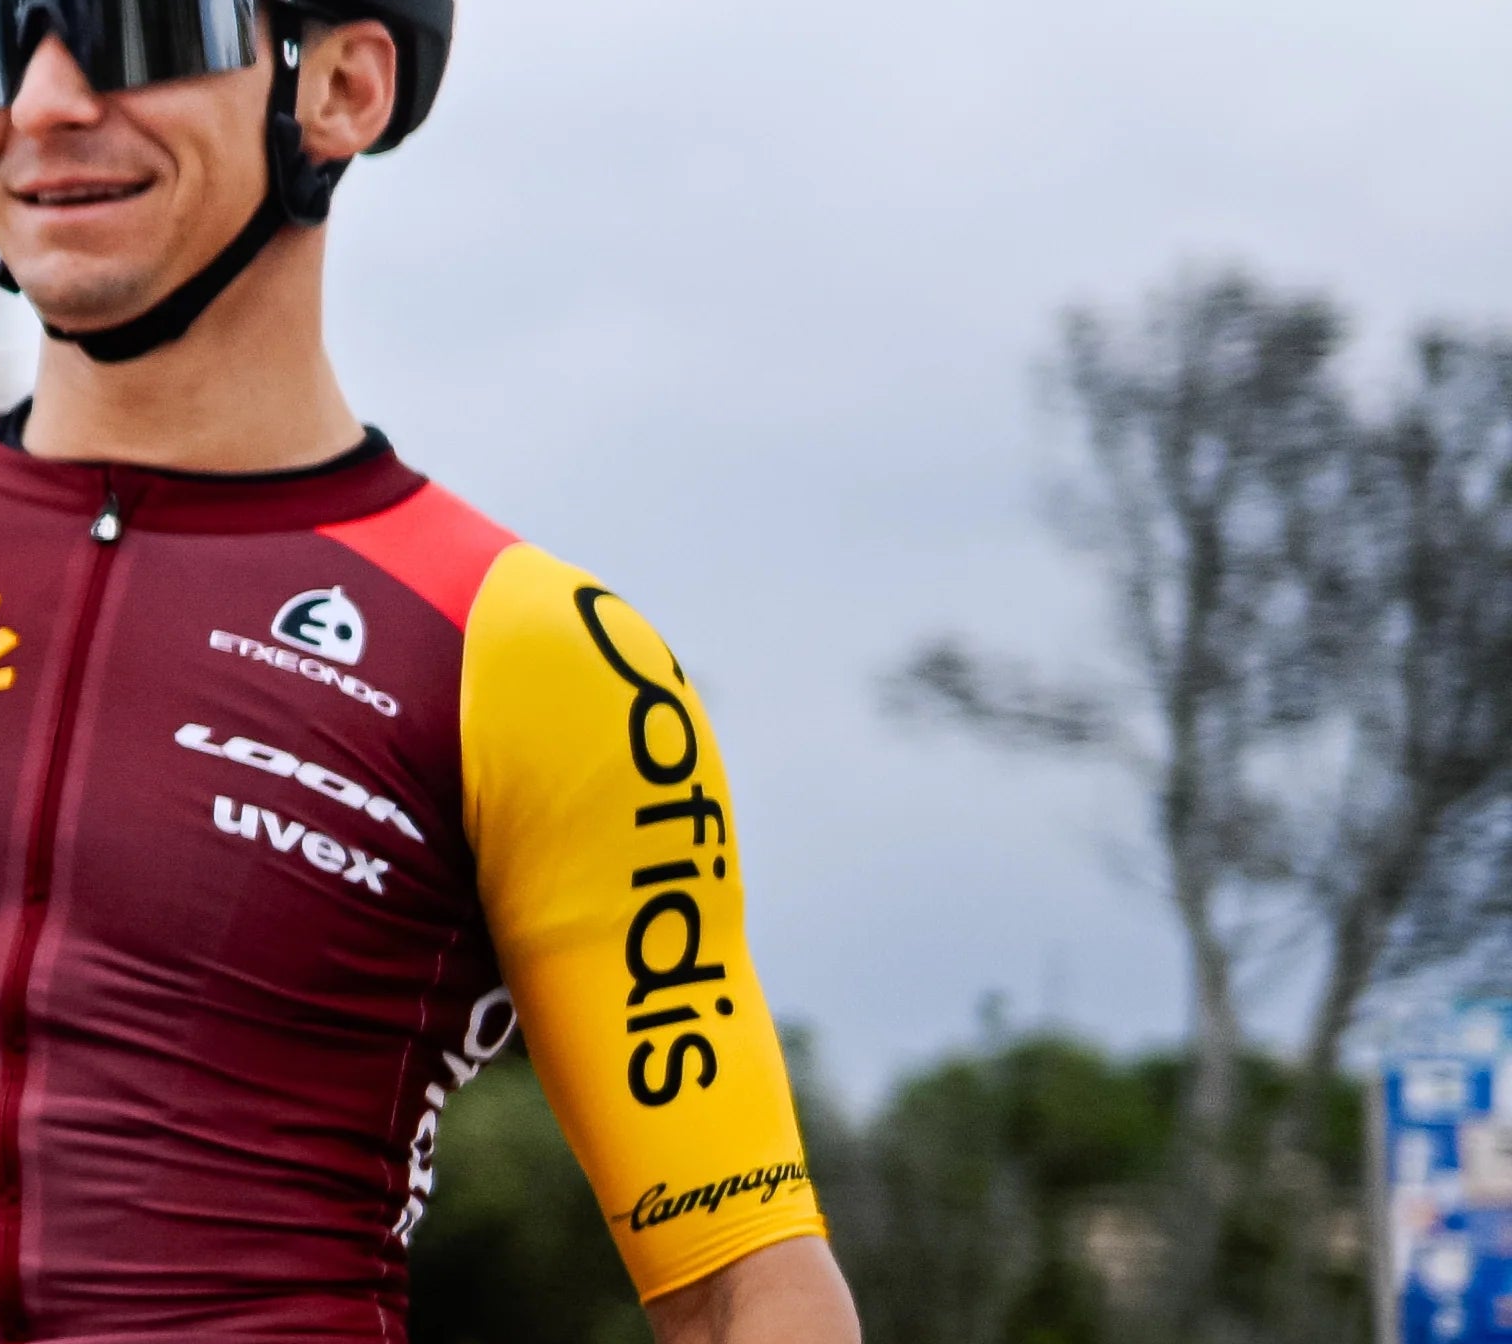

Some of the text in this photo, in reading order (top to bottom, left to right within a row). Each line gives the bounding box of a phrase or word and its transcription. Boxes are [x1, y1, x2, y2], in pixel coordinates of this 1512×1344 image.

[208, 629, 400, 718] ETXEONDO
[213, 794, 390, 895] uvex
[574, 585, 734, 1108] Cofidis
